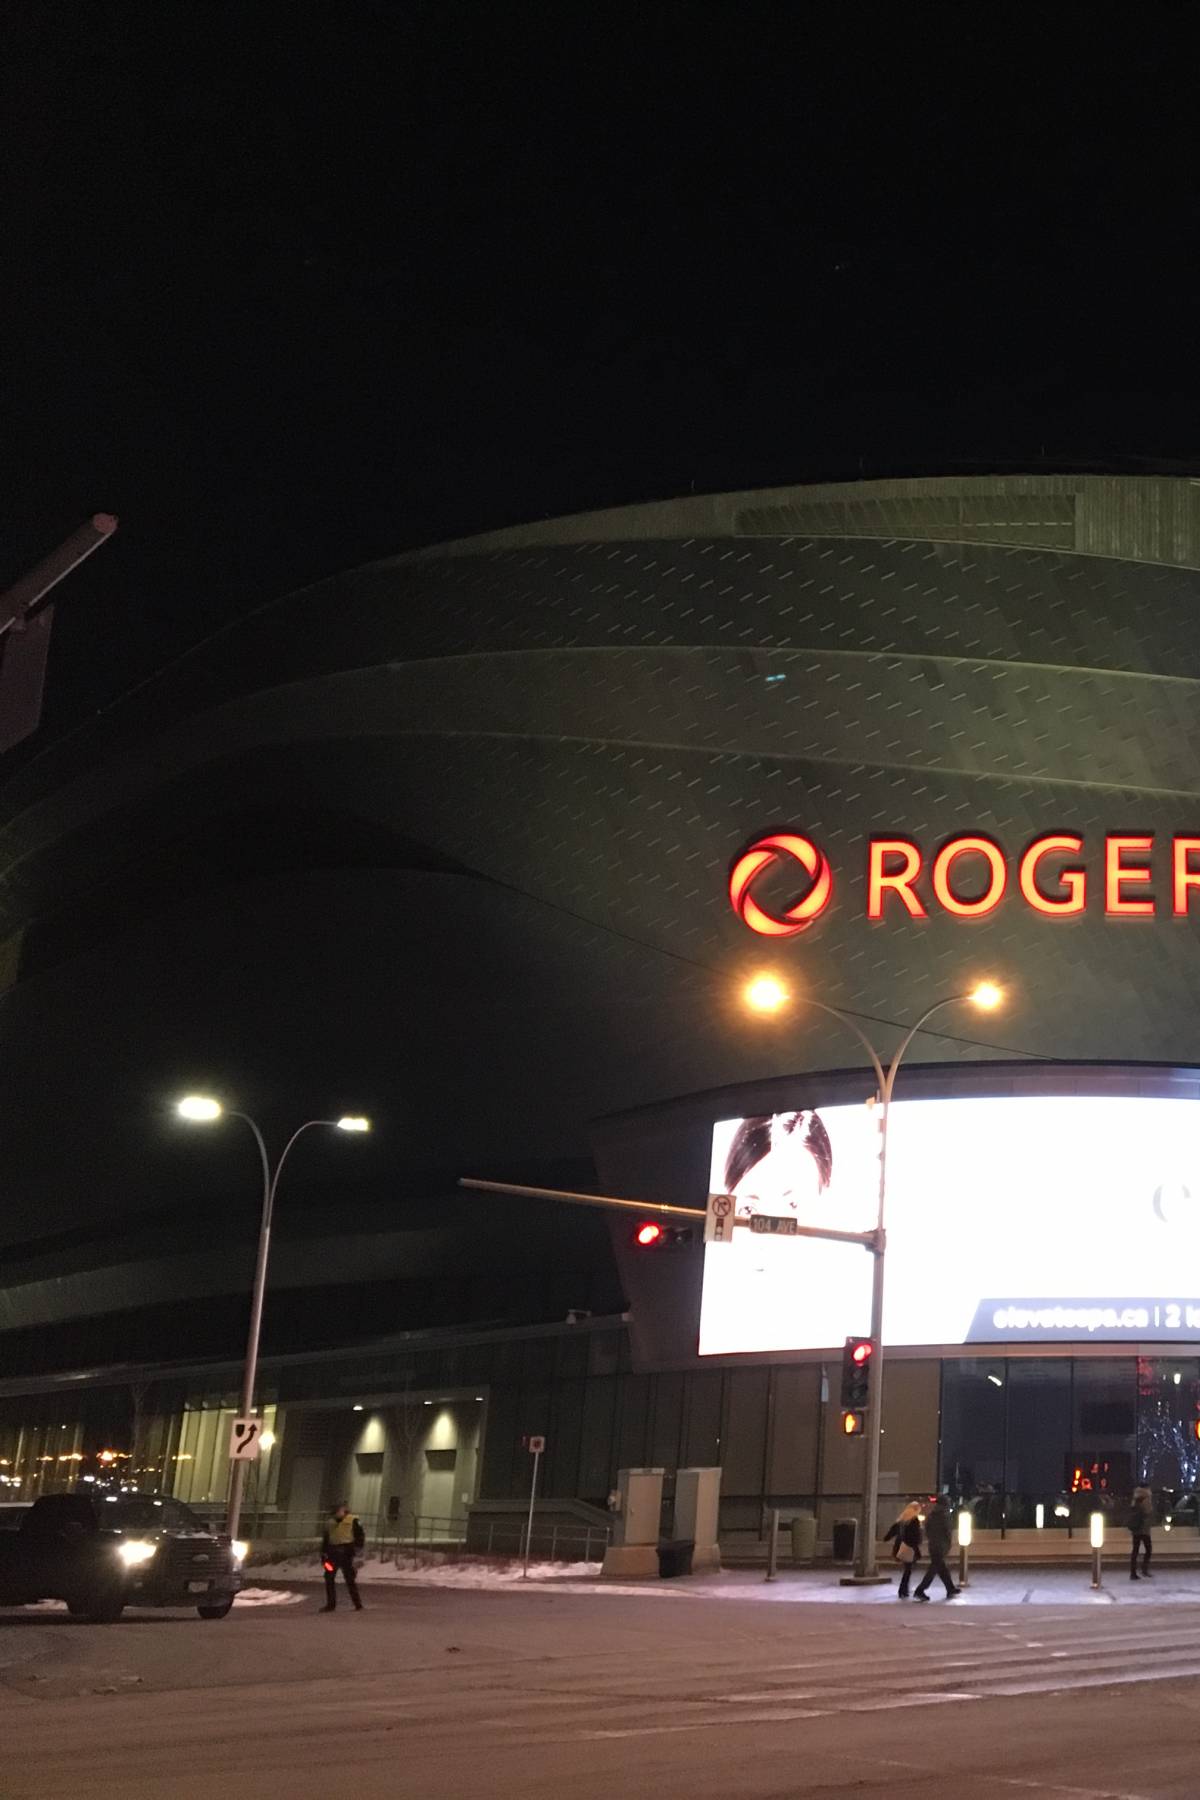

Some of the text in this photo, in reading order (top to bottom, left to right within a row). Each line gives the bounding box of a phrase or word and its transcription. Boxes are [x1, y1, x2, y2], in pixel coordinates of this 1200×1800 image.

[753, 1217, 796, 1234] 104 AVE
[1165, 1304, 1181, 1328] 2
